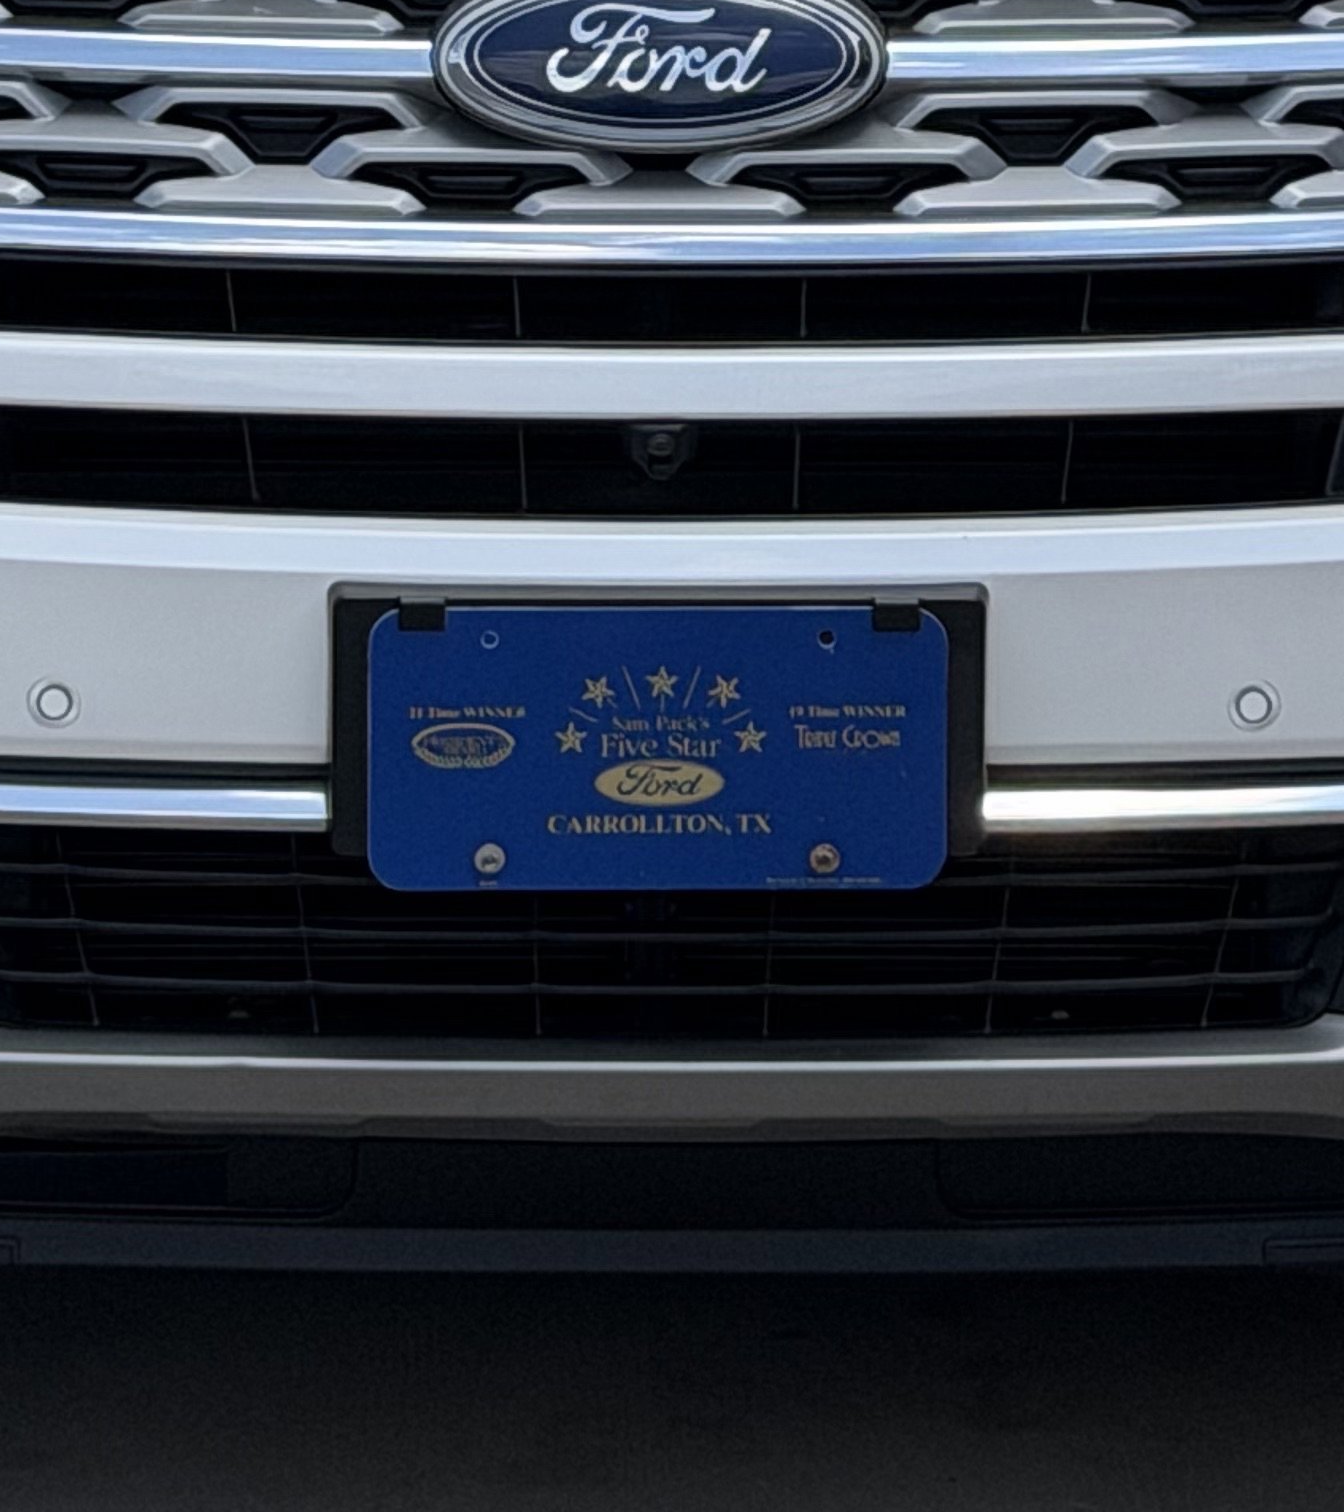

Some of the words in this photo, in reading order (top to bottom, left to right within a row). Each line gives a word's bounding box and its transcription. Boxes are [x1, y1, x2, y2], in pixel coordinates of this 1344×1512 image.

[546, 2, 772, 93] Ford
[612, 716, 650, 732] Sam
[656, 715, 710, 732] Pack's
[842, 705, 907, 718] WINNER
[601, 732, 658, 758] Five
[667, 732, 722, 758] Star
[616, 764, 703, 797] Ford
[547, 813, 732, 836] CARROLLTON,
[735, 813, 772, 834] TX
